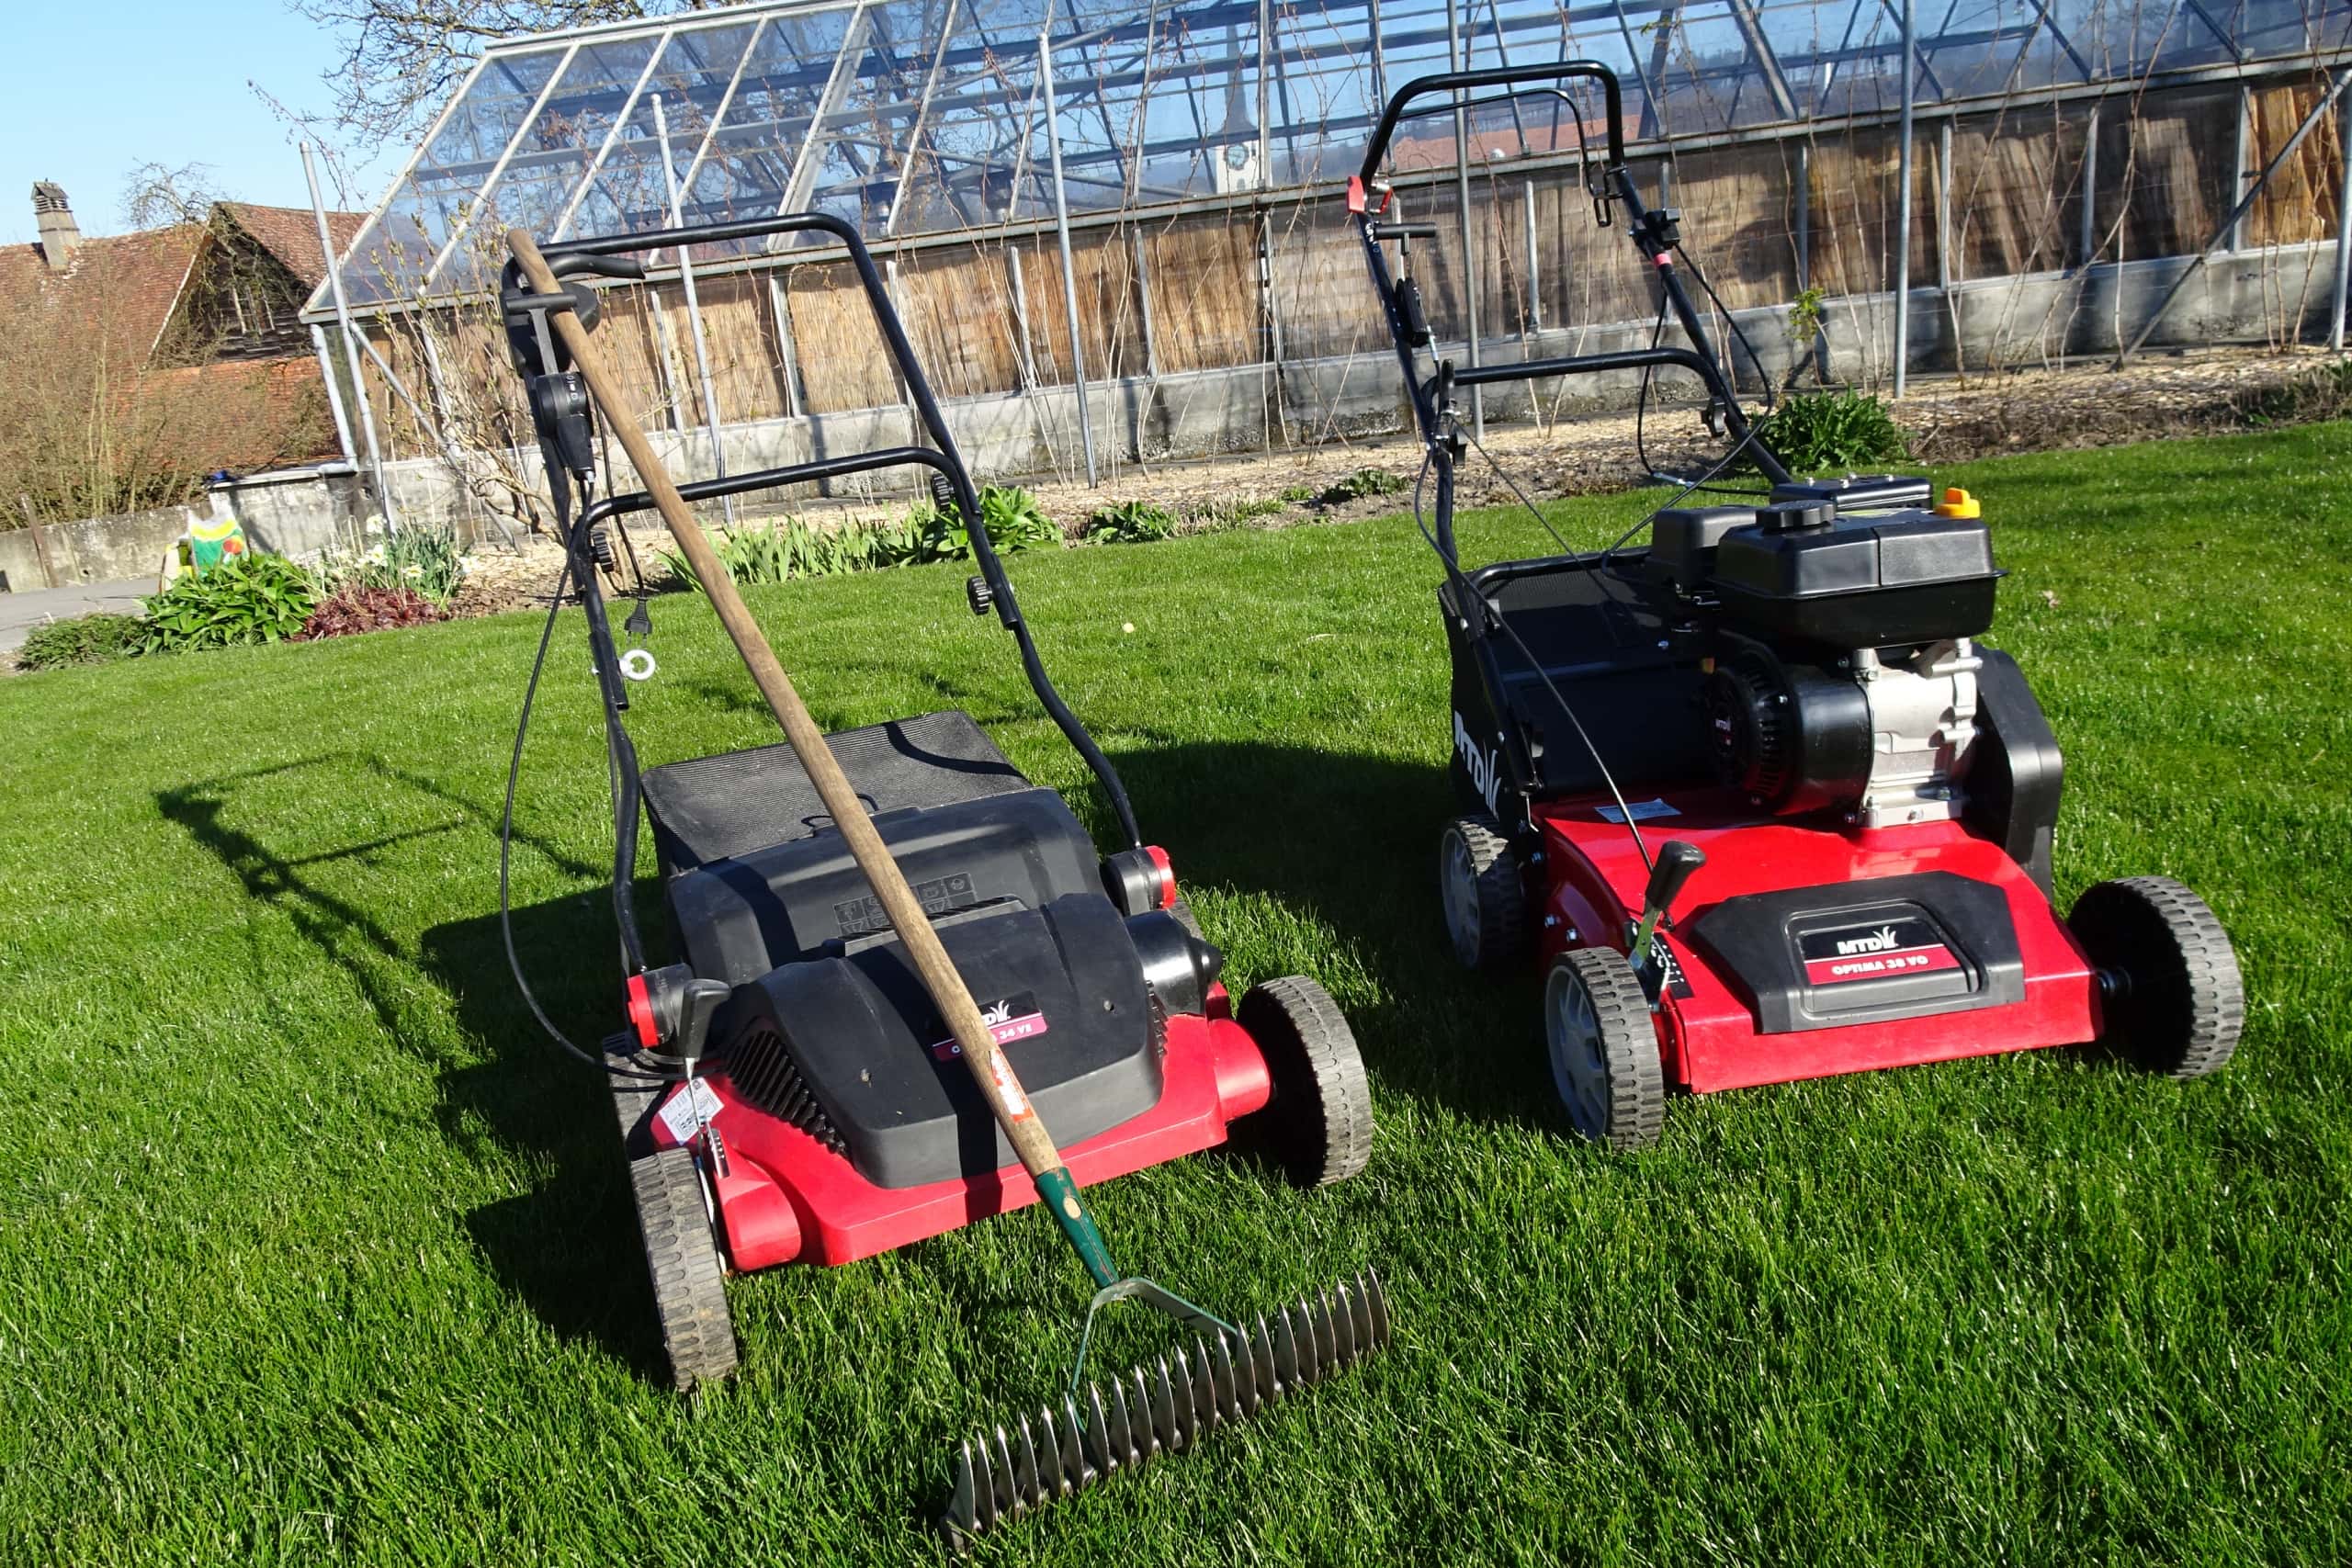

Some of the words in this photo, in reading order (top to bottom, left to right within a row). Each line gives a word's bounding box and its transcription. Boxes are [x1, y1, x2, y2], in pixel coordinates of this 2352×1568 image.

[1454, 711, 1486, 795] MTD
[1838, 937, 1883, 954] MTD
[1832, 961, 1885, 975] OPTIMA
[1886, 958, 1905, 968] 38
[1000, 1029, 1015, 1039] 34
